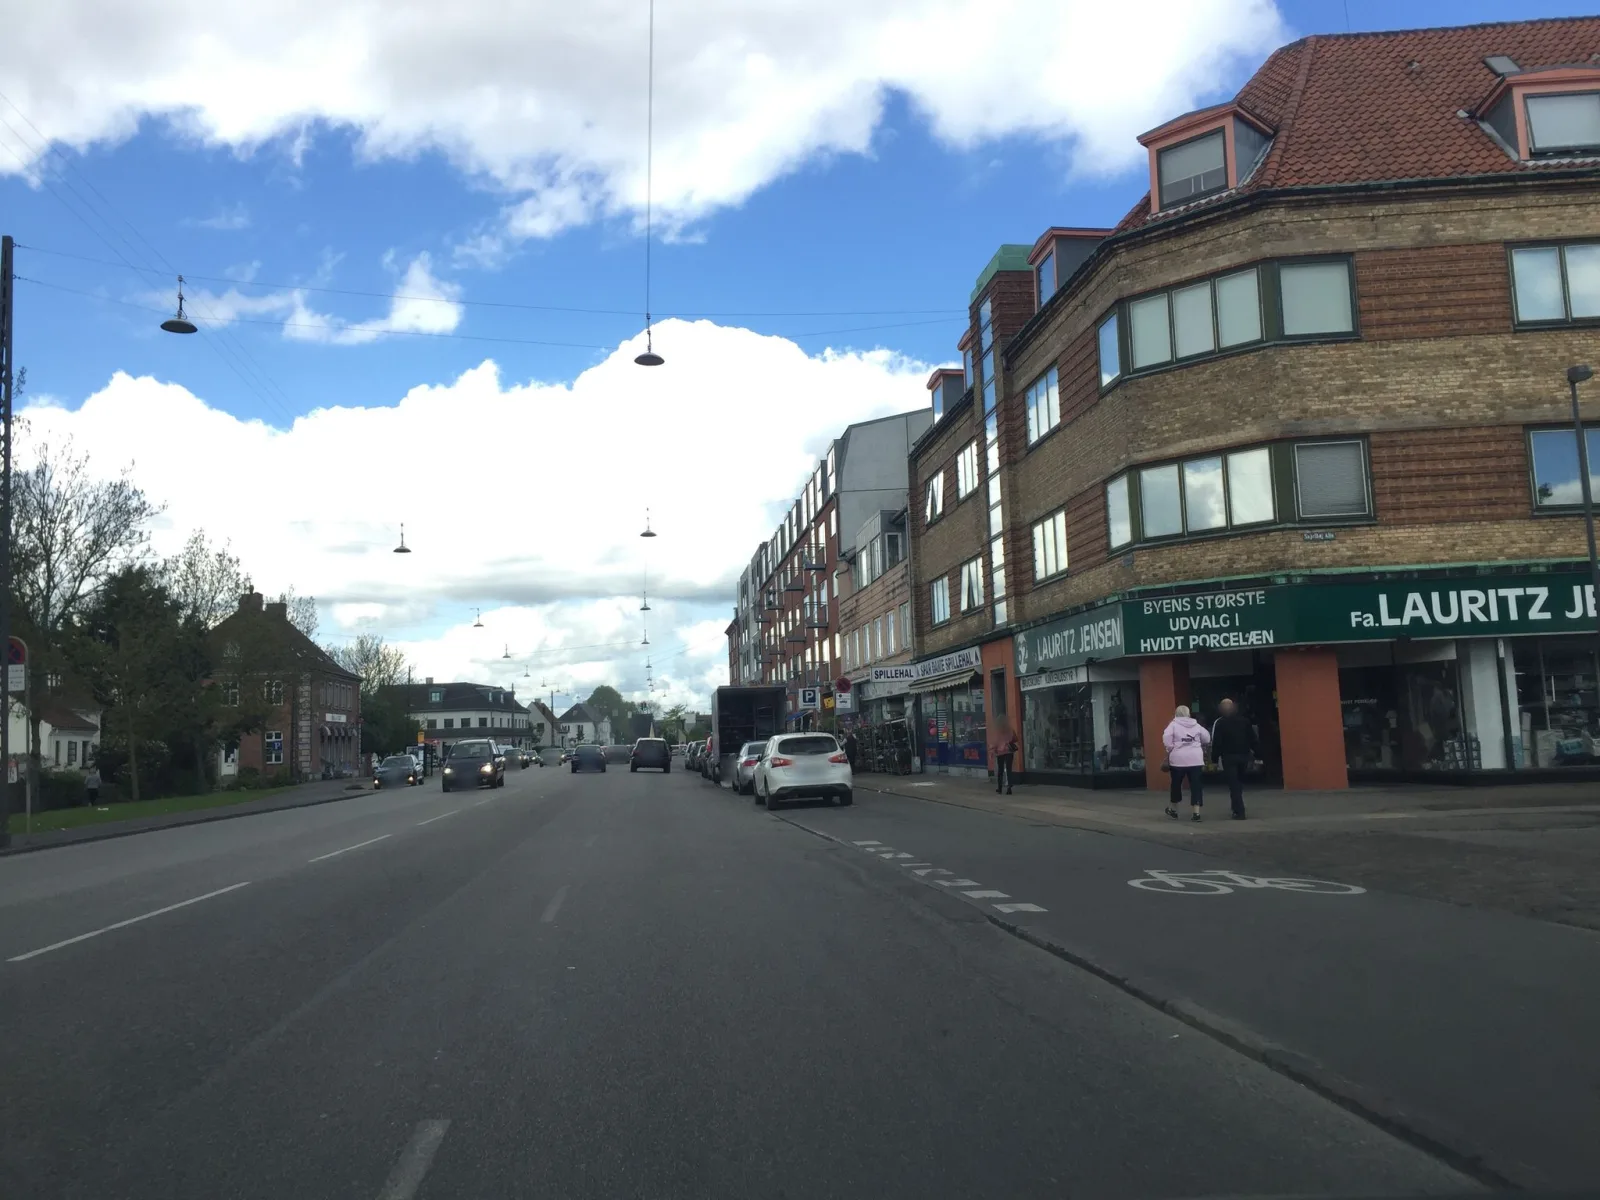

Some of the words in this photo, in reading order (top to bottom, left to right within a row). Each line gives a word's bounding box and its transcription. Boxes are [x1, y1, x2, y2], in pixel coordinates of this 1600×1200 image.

[1143, 597, 1191, 615] BYENS
[1196, 590, 1265, 610] STØRSTE
[1350, 611, 1379, 628] Fa.
[1378, 586, 1552, 626] LAURITZ
[1169, 613, 1230, 631] UDVALG
[1235, 612, 1240, 627] I
[1036, 628, 1076, 661] LAURITZ
[1079, 617, 1121, 653] JENSEN
[1140, 636, 1184, 652] HVIDT
[1189, 629, 1275, 649] PORCELÆN
[874, 668, 914, 680] SPILLEHAL
[805, 690, 814, 702] P
